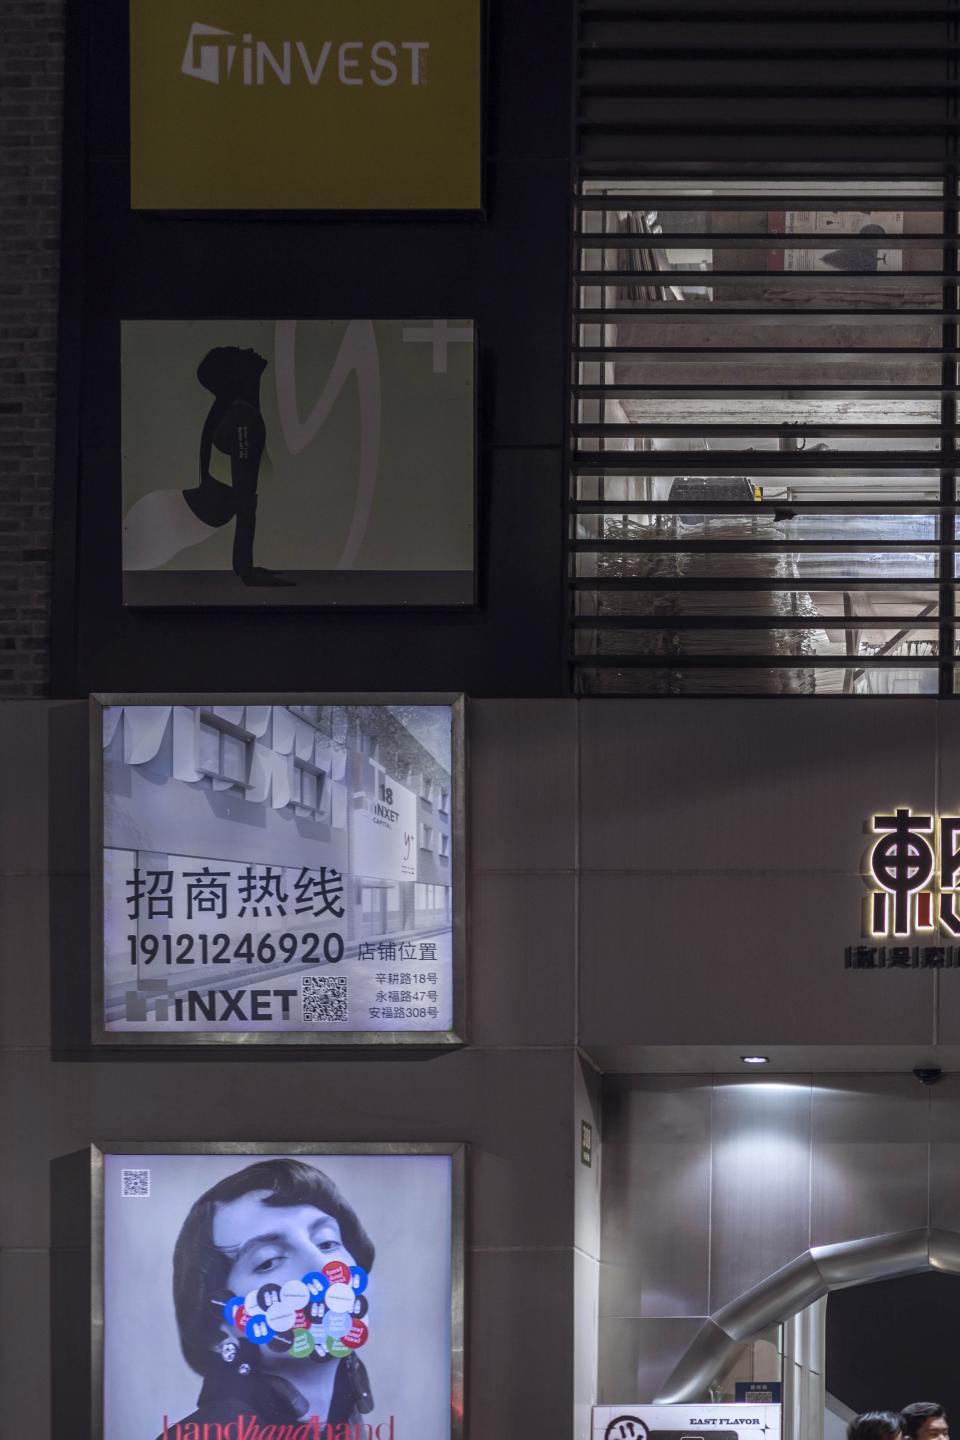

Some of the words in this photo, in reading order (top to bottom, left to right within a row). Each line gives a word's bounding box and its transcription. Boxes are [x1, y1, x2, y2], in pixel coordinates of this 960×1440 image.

[380, 783, 394, 805] 18
[125, 866, 346, 920] 招商热线
[127, 932, 345, 965] 19121246920
[357, 942, 438, 961] 店铺位置
[375, 972, 438, 985] 辛耕路18号
[375, 990, 439, 1003] 永福路47号
[368, 1006, 439, 1019] 安福路308号
